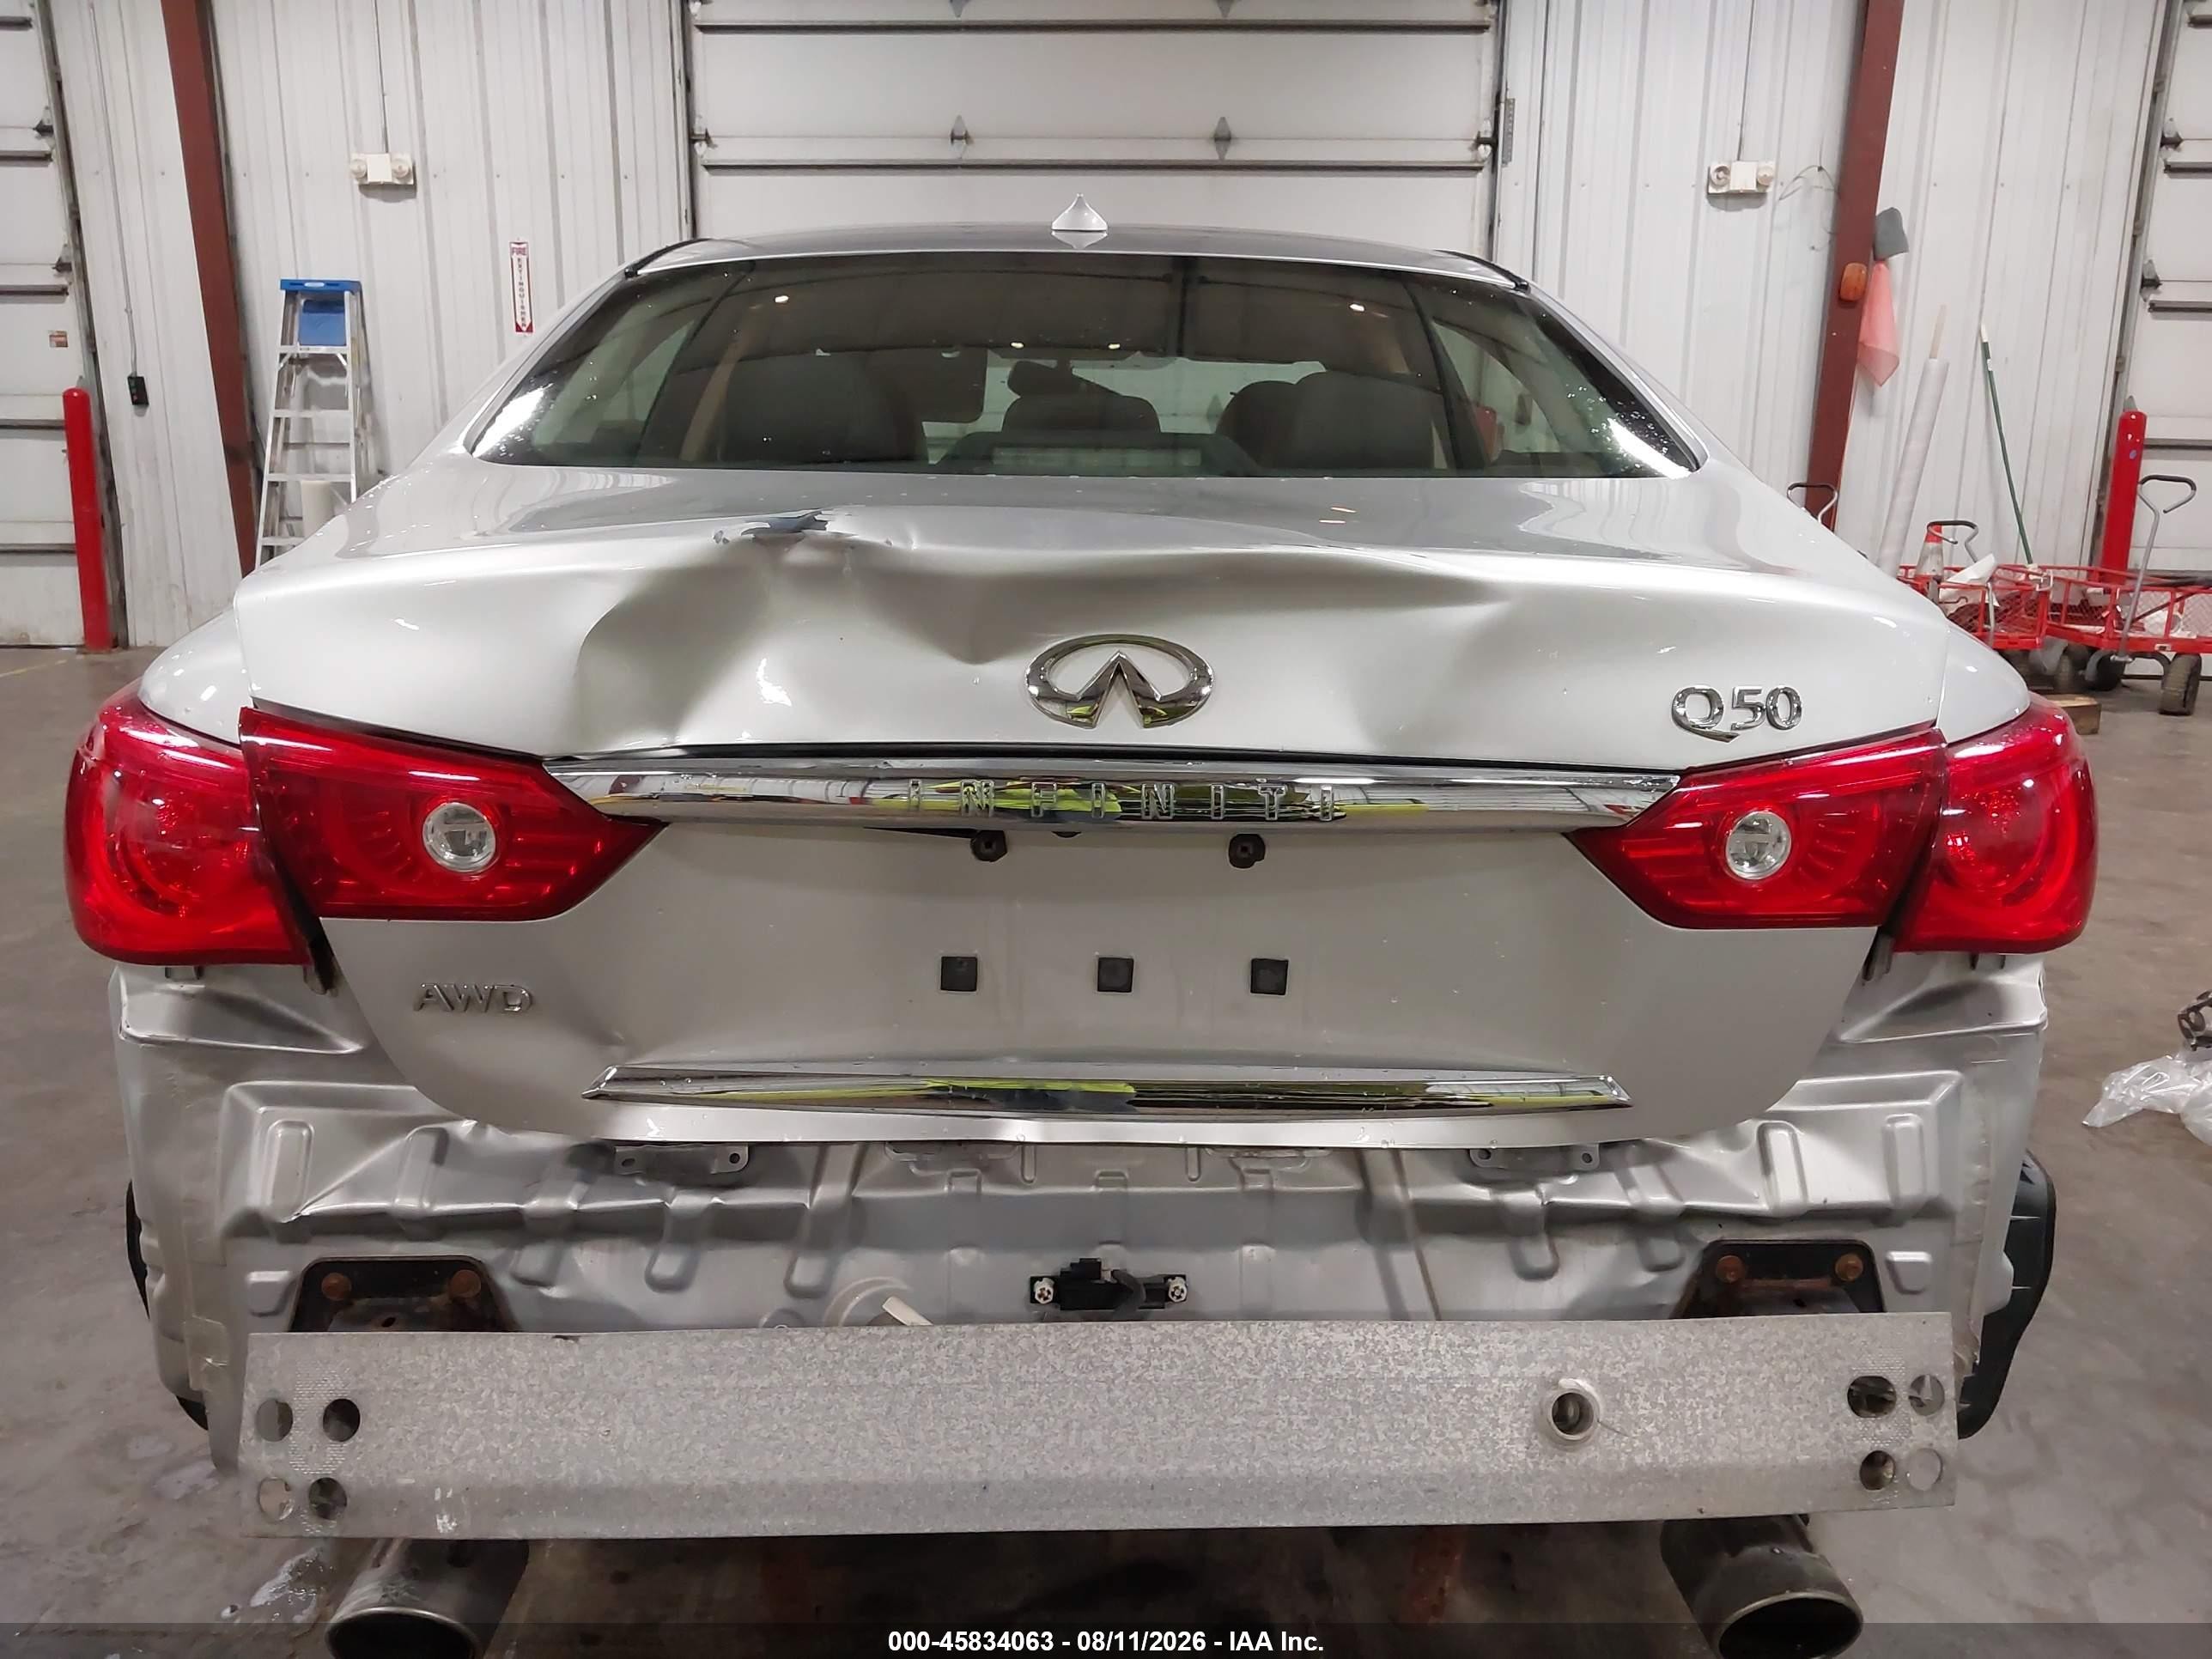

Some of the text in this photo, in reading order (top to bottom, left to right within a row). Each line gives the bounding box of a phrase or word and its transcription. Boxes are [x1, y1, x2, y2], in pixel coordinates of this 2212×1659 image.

[512, 246, 526, 256] FIRE
[1671, 685, 1802, 743] Q50
[907, 778, 1334, 822] INFINITI
[413, 983, 533, 1013] AWD
